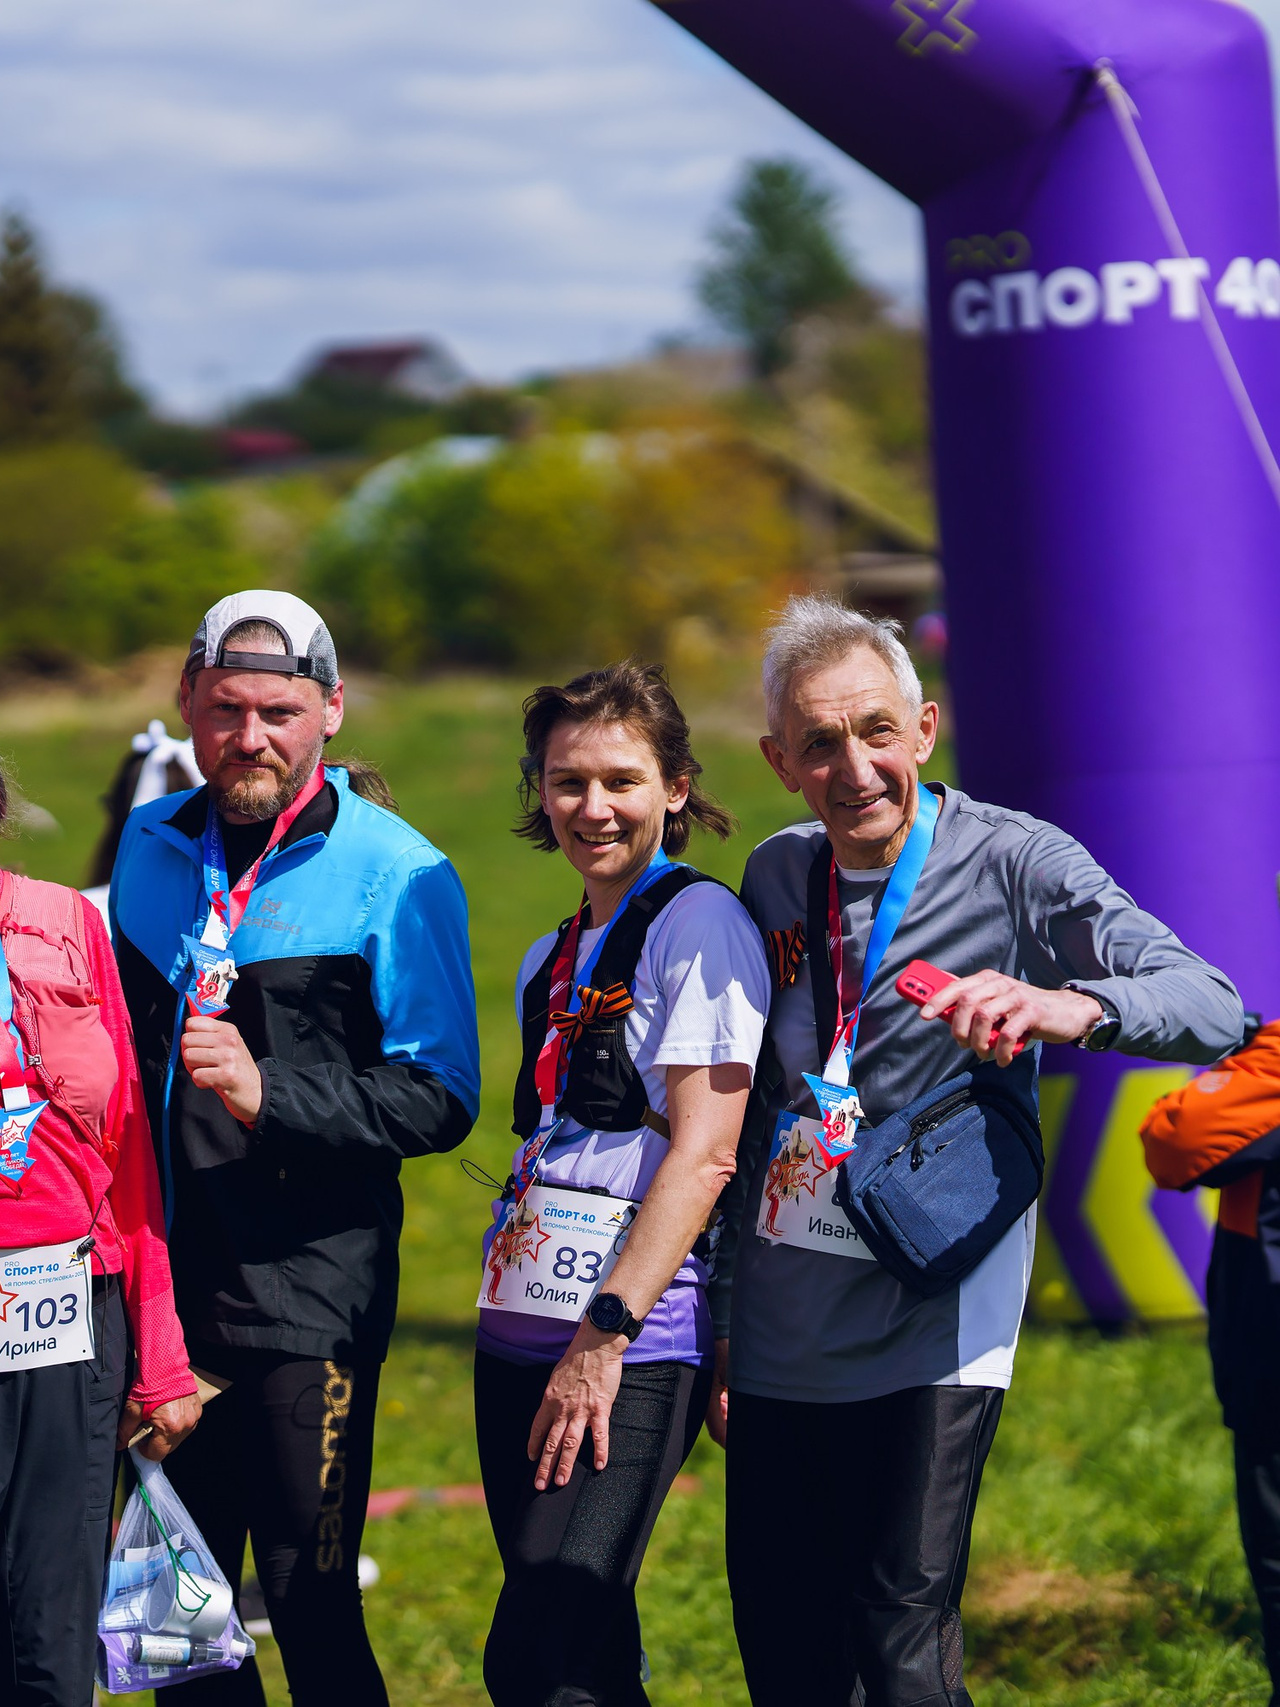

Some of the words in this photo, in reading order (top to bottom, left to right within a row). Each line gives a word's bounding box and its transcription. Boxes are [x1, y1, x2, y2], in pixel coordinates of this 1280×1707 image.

[951, 257, 1210, 336] СПОРТ
[241, 917, 301, 935] ORDSKI
[543, 1207, 580, 1221] СПОРТ
[581, 1213, 596, 1223] 40
[545, 1200, 558, 1208] PRO
[808, 1216, 858, 1241] Иван
[4, 1265, 44, 1276] СПОРТ
[45, 1263, 60, 1272] 40
[553, 1246, 603, 1284] 83
[525, 1281, 579, 1305] Юлия
[15, 1293, 78, 1332] 103
